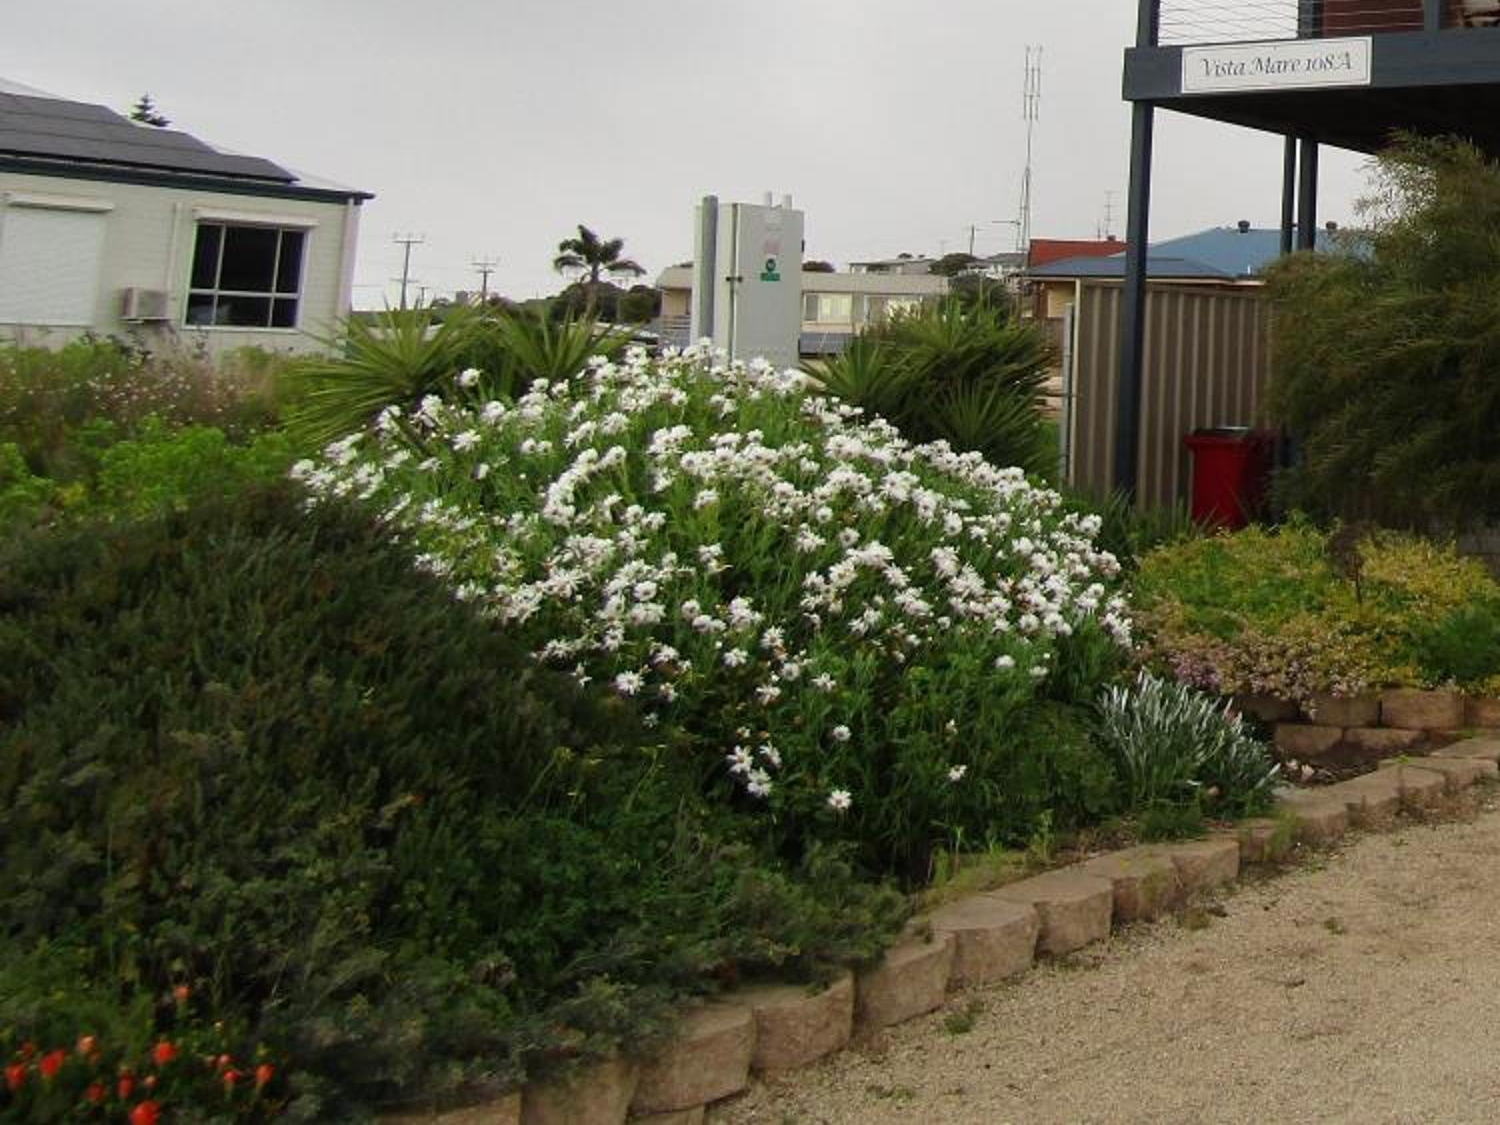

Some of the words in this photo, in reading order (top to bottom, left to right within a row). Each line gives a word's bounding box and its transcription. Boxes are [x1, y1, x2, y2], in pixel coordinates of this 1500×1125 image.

[1202, 58, 1245, 77] Vista
[1250, 55, 1301, 75] Mare
[1305, 50, 1354, 72] 108A
